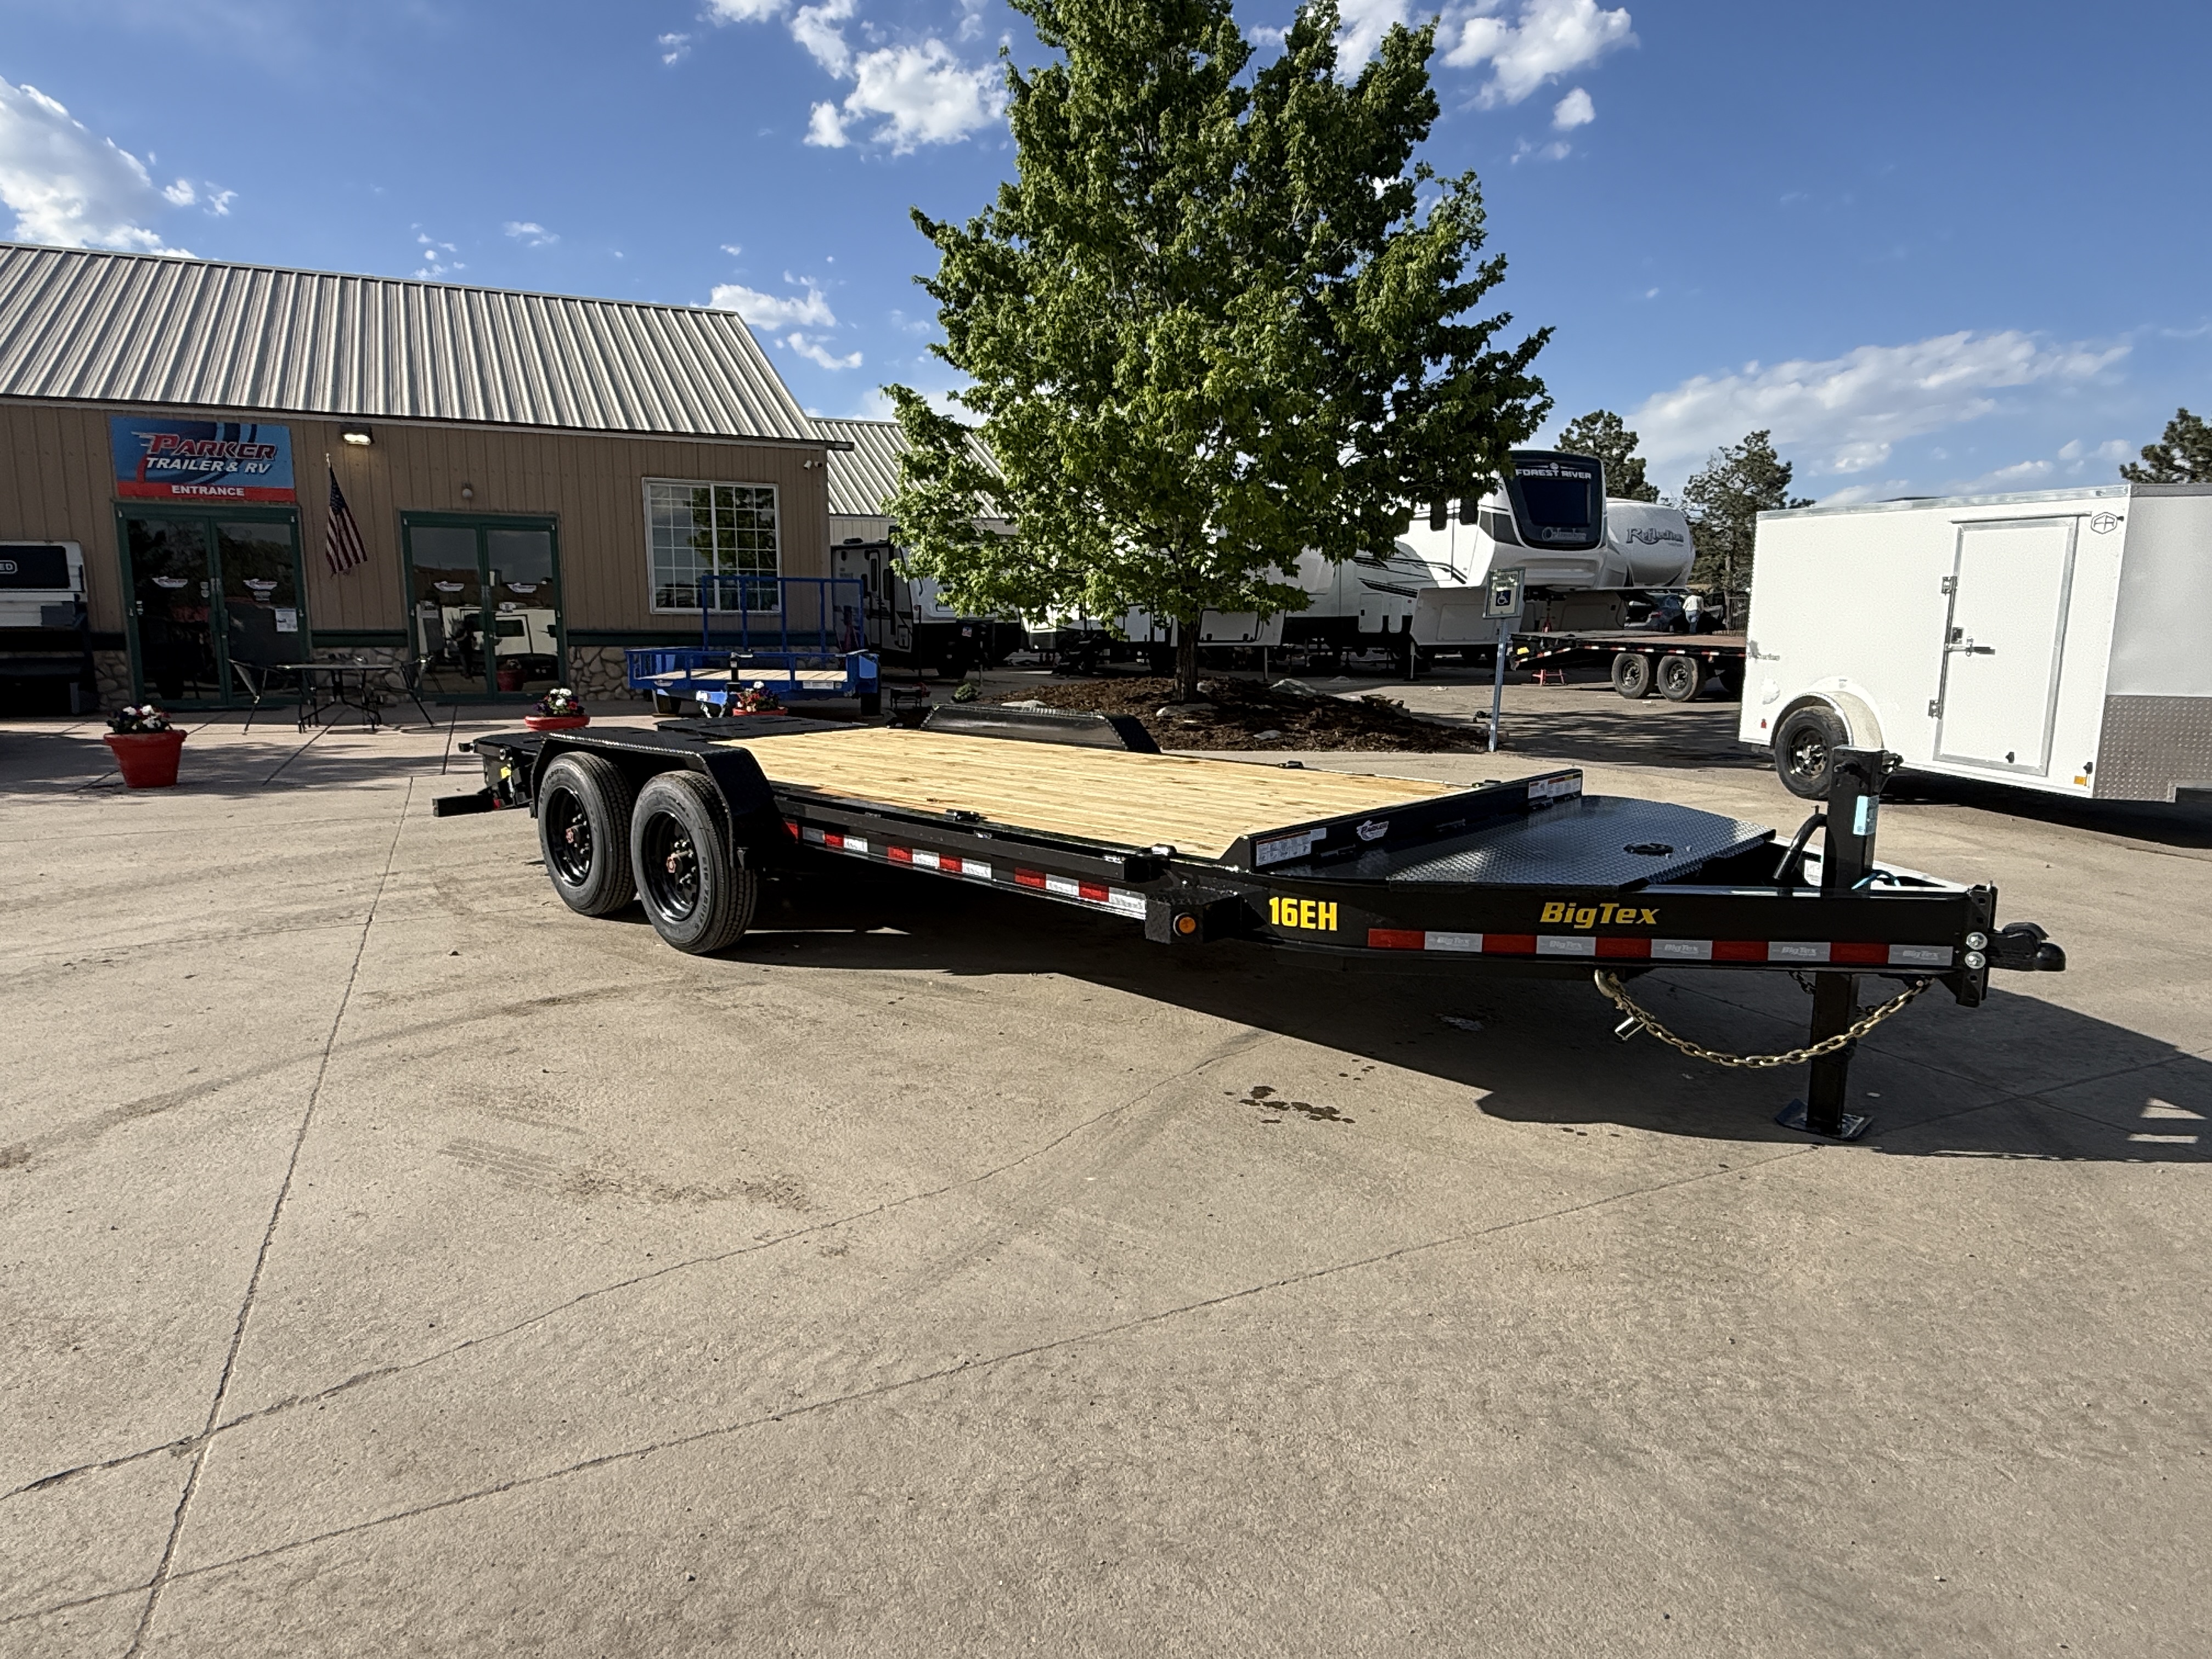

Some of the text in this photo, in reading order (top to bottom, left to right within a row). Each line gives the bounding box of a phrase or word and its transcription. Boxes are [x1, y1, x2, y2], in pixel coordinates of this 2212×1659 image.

[140, 433, 276, 460] PARKER
[146, 457, 271, 473] TRAILER & RV
[1515, 469, 1591, 479] FOREST RIVER
[171, 485, 245, 496] ENTRANCE
[1269, 897, 1338, 931] 16EH
[1539, 902, 1660, 929] BigTex
